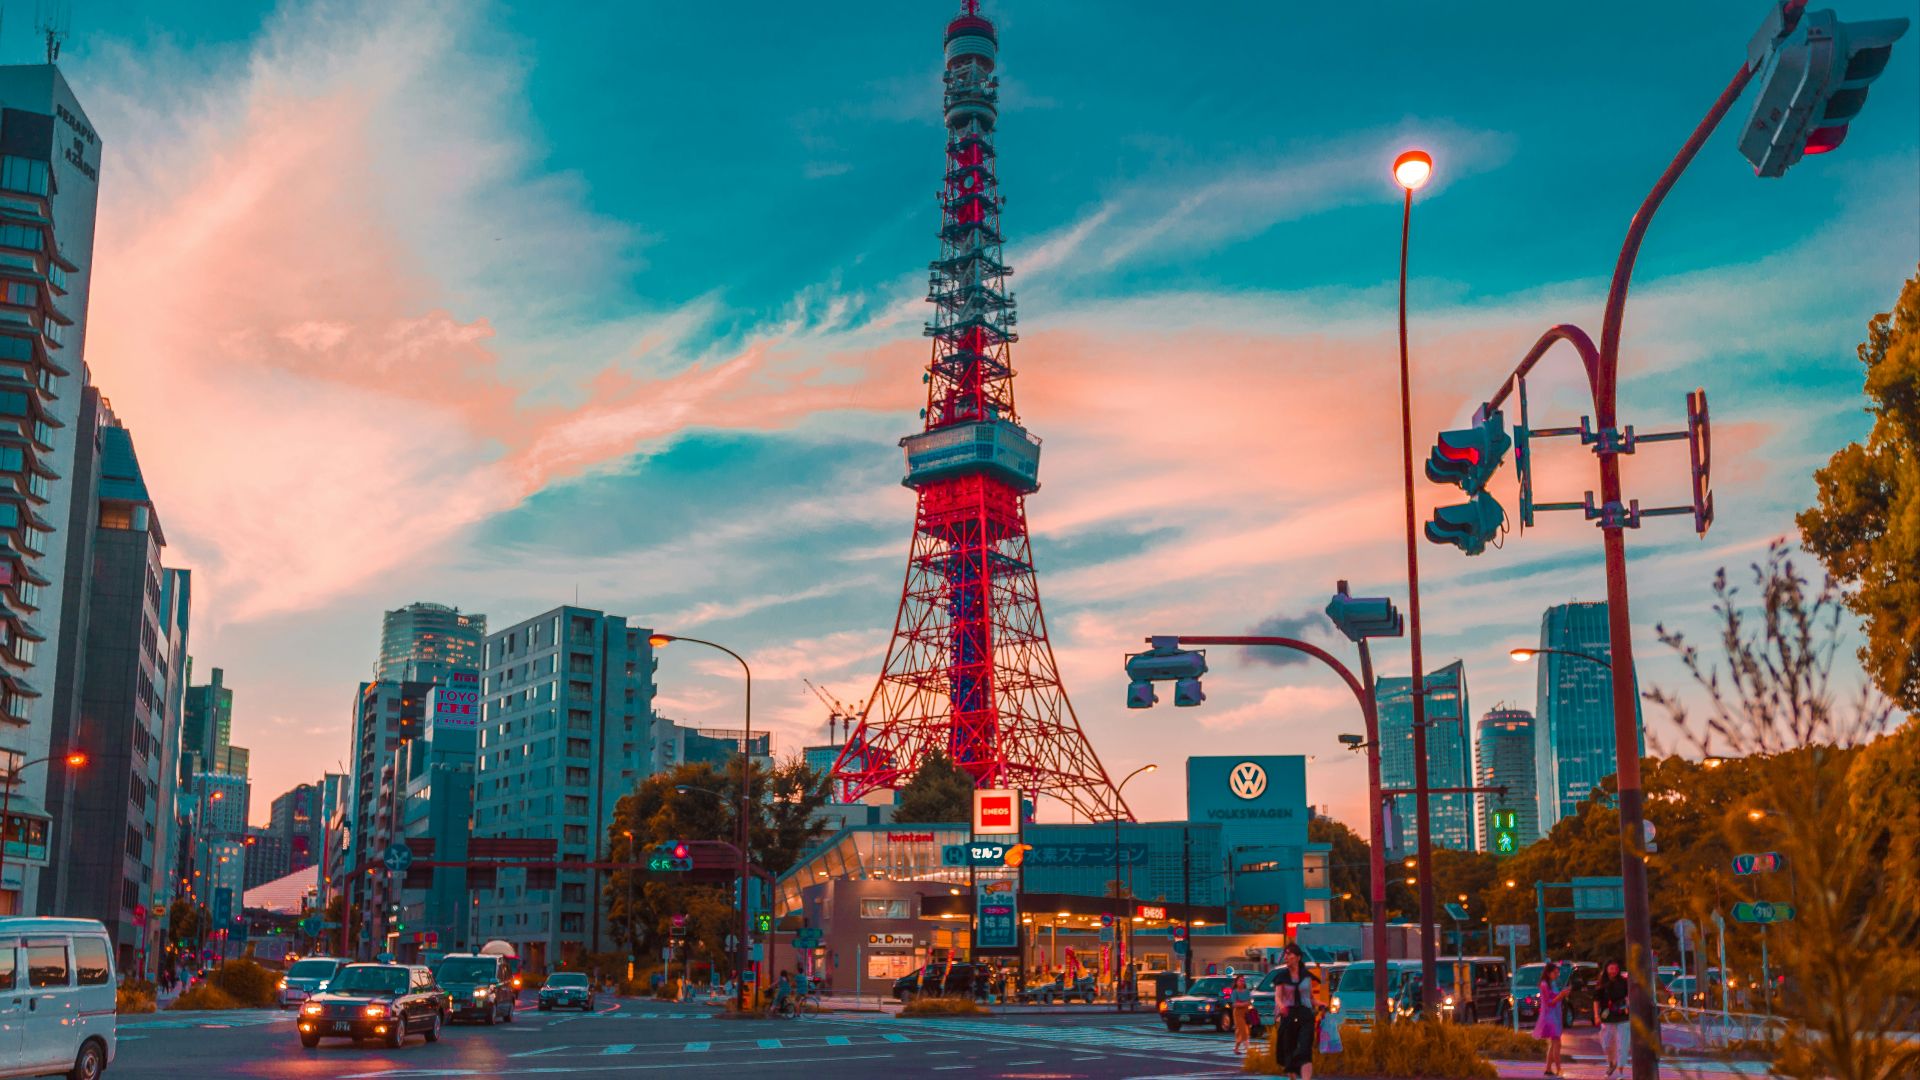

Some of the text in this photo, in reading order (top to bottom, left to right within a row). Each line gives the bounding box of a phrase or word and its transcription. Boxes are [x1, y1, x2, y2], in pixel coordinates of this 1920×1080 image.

[56, 103, 95, 145] SERAPH
[983, 807, 1009, 816] ENEOS
[1207, 807, 1293, 819] VOLKSWAGEN
[970, 846, 1003, 860] セルフ
[1025, 846, 1145, 863] 水素ステーション
[1143, 907, 1164, 919] ENEOS
[885, 934, 913, 944] Drive
